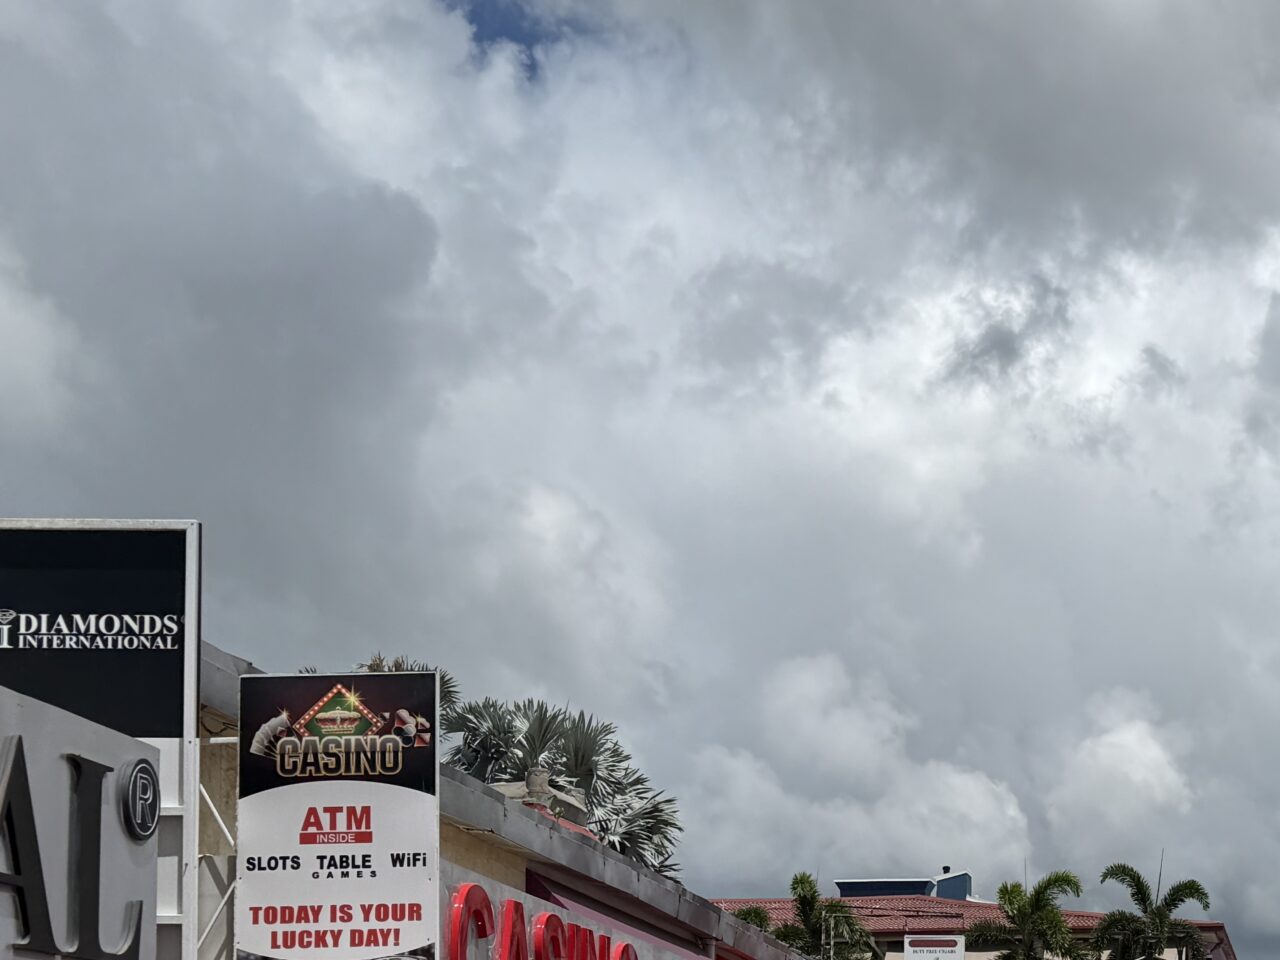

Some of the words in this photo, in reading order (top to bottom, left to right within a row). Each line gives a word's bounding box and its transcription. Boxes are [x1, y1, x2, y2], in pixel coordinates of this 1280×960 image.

[18, 614, 178, 635] DIAMONDS
[18, 635, 178, 650] INTERNATIONAL
[276, 735, 402, 777] CASINO
[301, 806, 371, 831] ATM
[316, 834, 355, 843] INSIDE
[246, 856, 301, 871] SLOTS
[317, 855, 372, 870] TABLE
[390, 853, 427, 868] WiFi
[312, 871, 377, 879] GAMES
[249, 905, 323, 925] TODAY
[330, 904, 353, 923] IS
[360, 903, 422, 922] YOUR
[271, 930, 343, 949] LUCKY
[350, 928, 400, 948] DAY!
